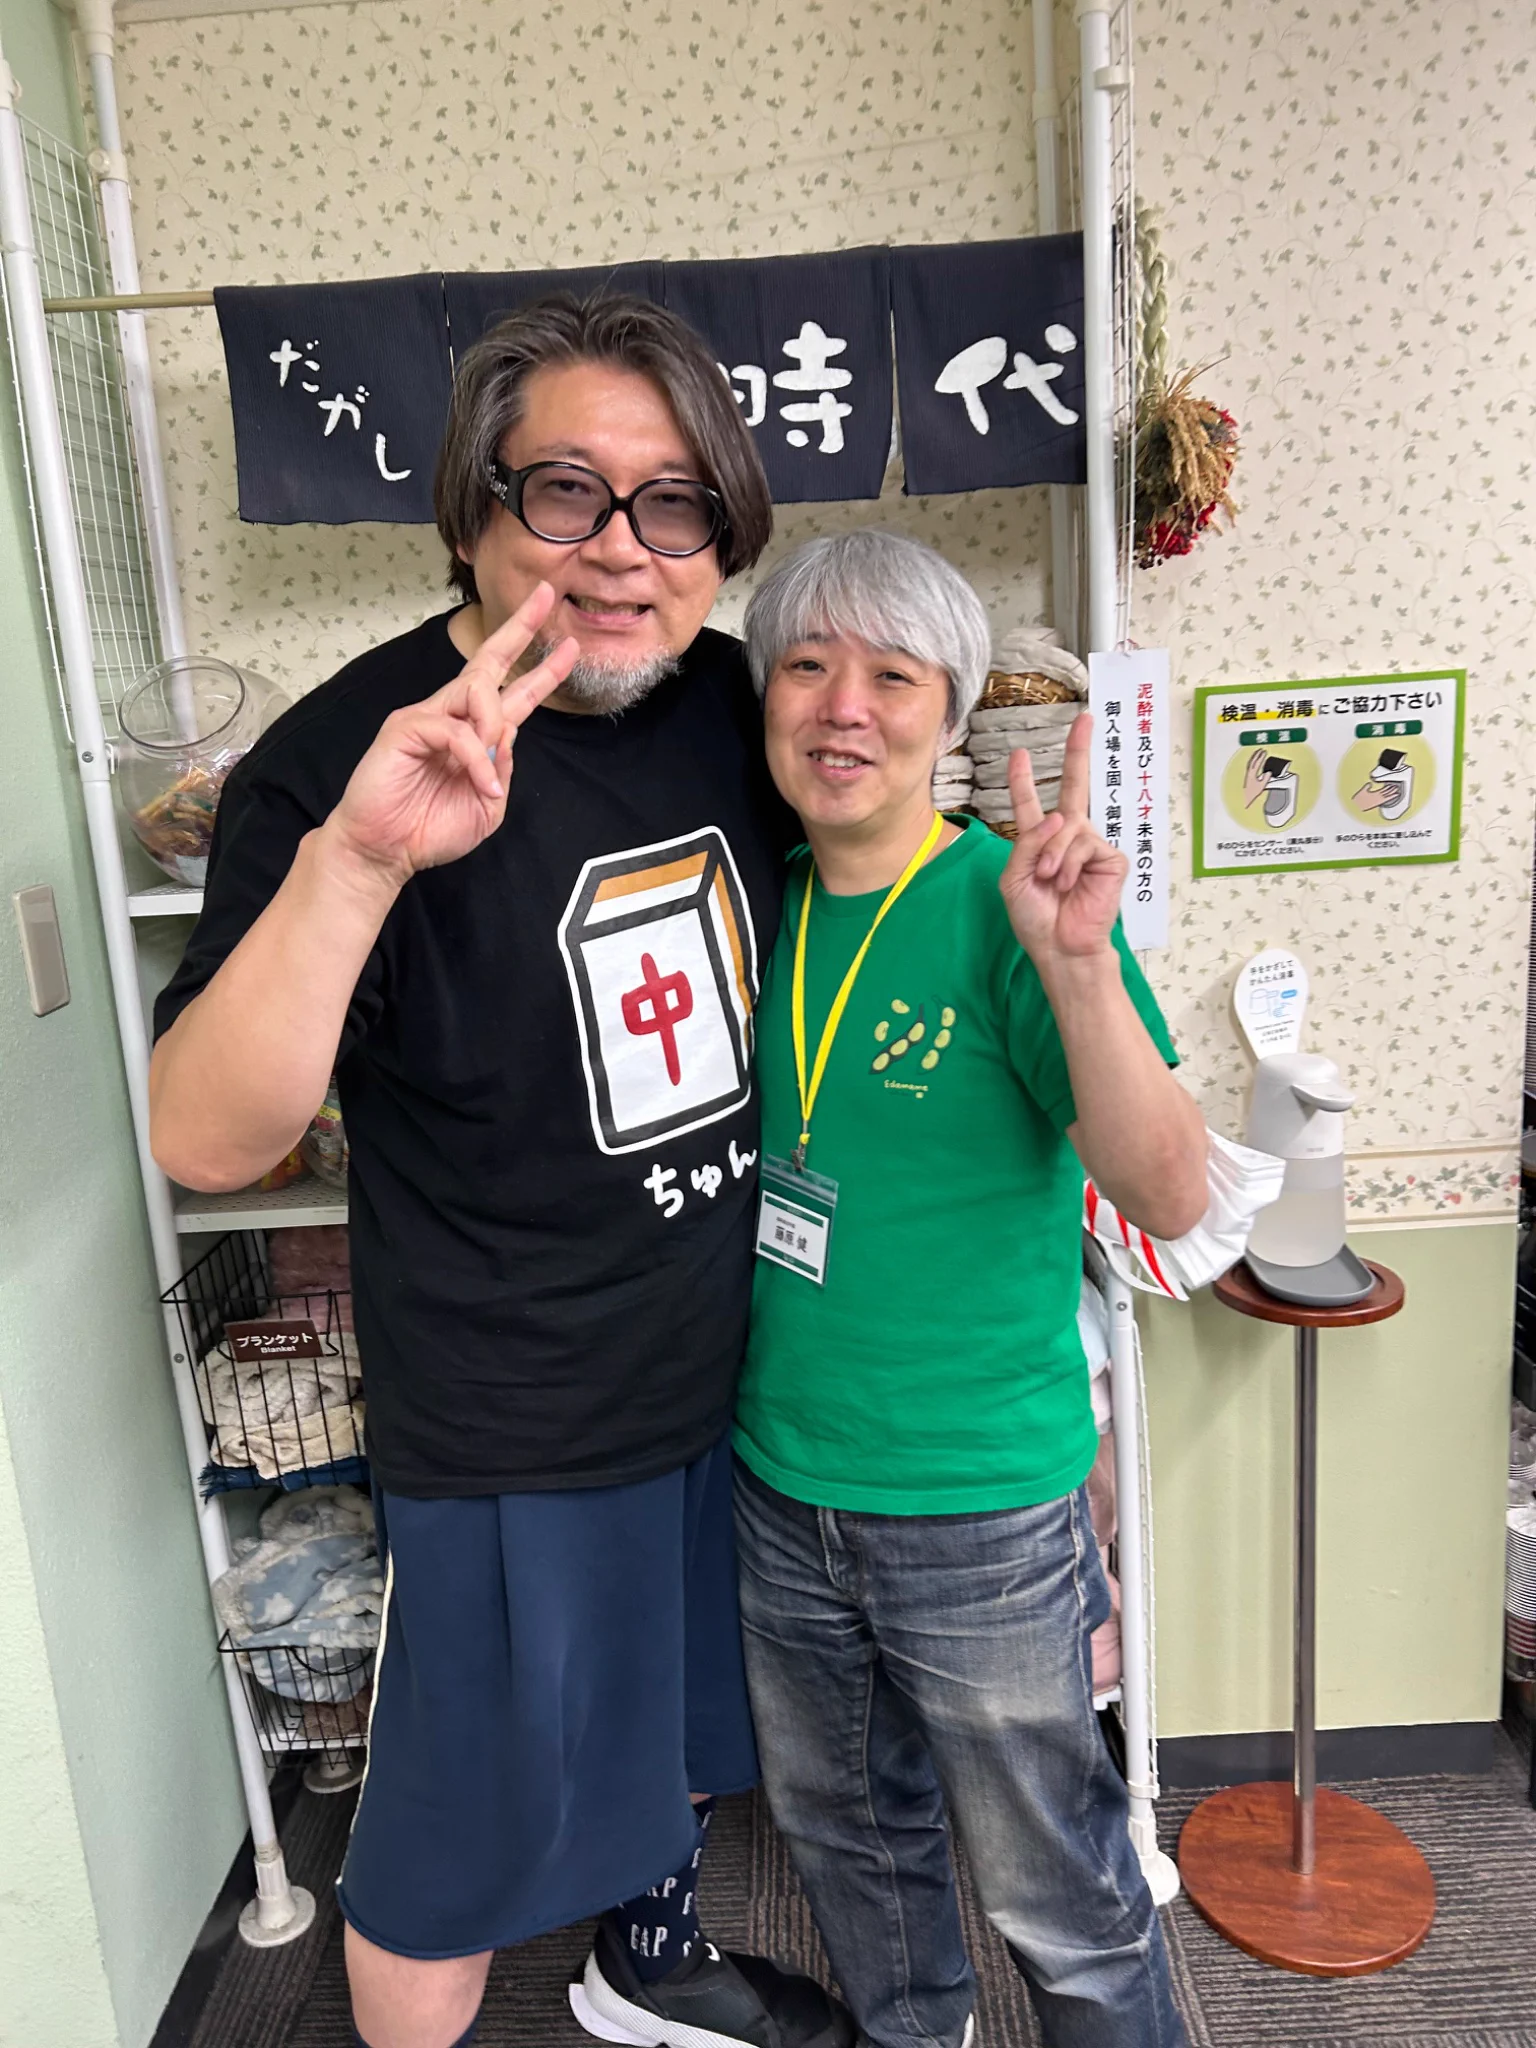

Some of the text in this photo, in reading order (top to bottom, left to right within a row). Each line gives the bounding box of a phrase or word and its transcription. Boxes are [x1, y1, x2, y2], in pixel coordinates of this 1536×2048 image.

[269, 338, 412, 481] だがし
[1220, 692, 1443, 723] 検温・消毒にご協力下さい
[1136, 683, 1153, 903] 泥酔者及び十八才未満の方の
[621, 952, 694, 1087] 中
[643, 1140, 758, 1218] ちゅん
[260, 1345, 297, 1354] Blanket
